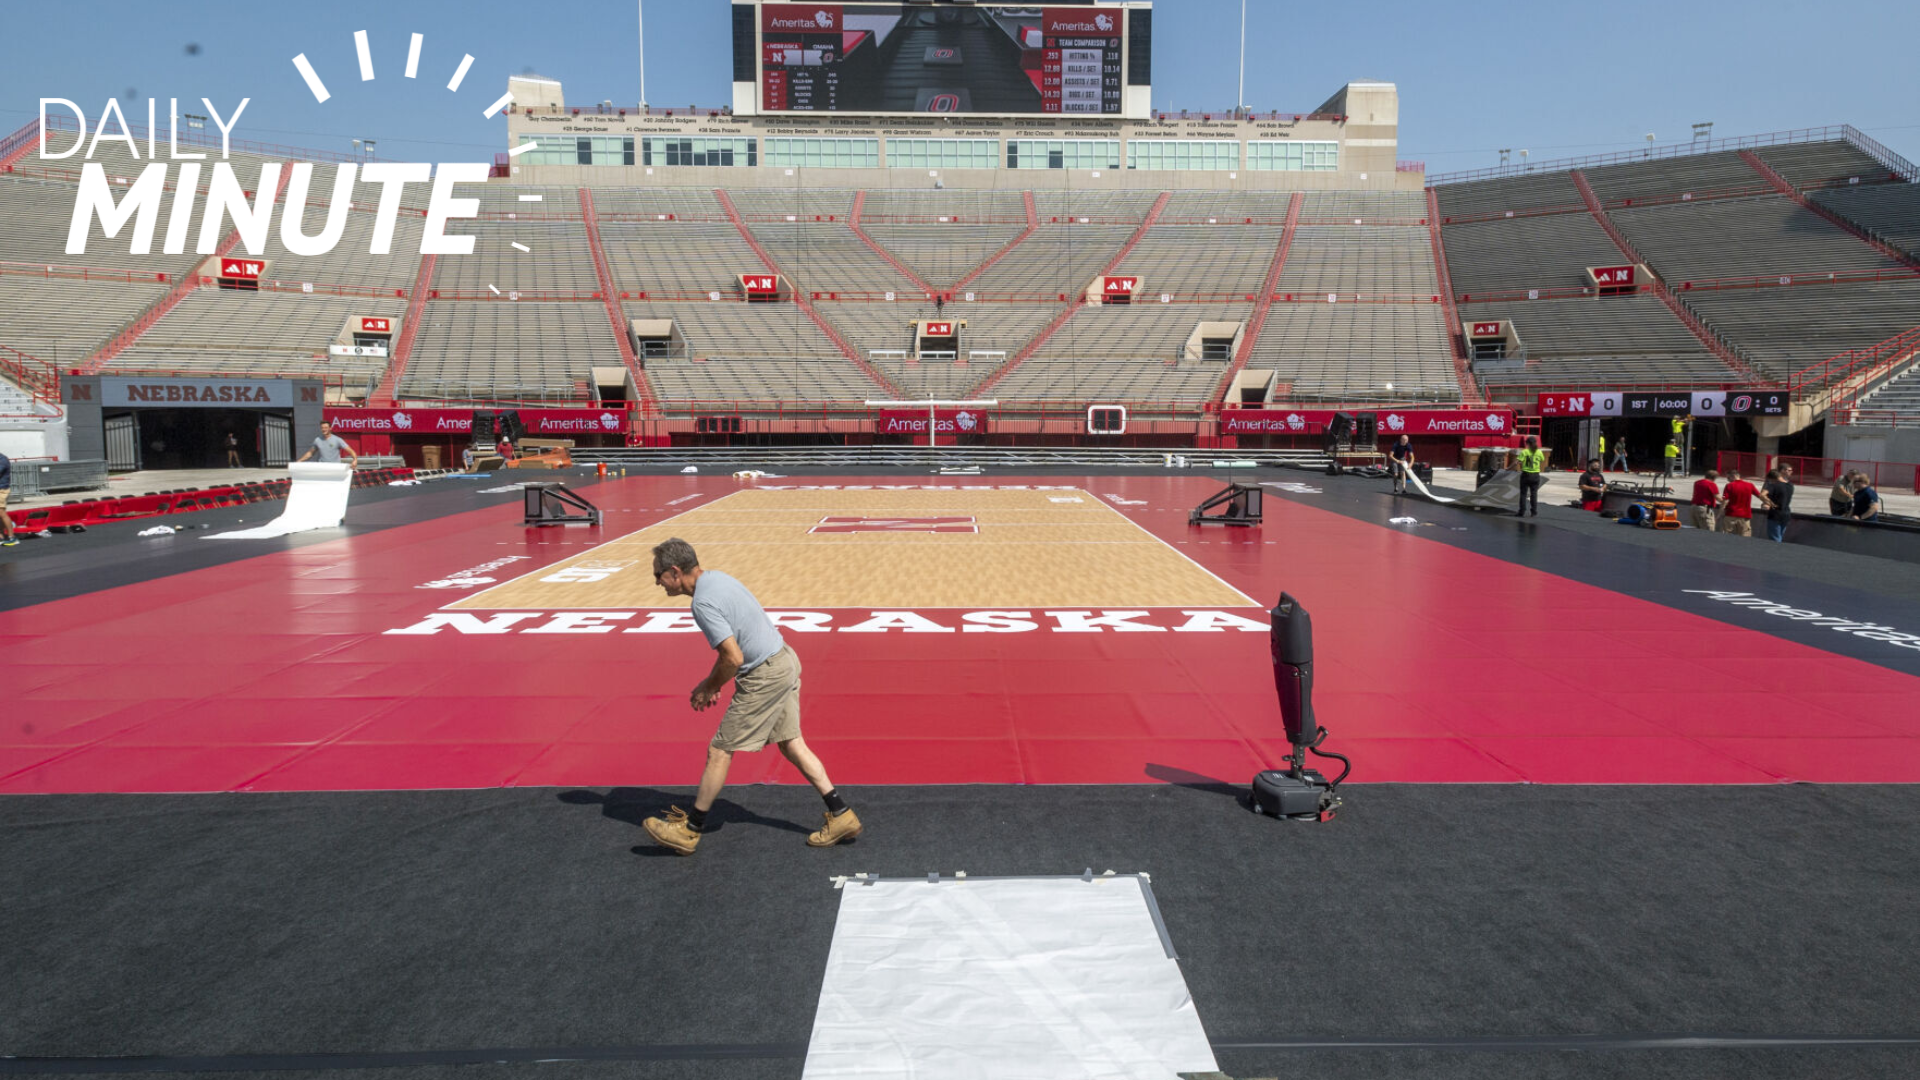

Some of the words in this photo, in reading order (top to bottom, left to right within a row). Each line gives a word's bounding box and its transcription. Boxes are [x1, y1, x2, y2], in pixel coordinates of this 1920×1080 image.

[771, 17, 816, 28] Ameritas
[1051, 21, 1096, 31] Ameritas
[1059, 39, 1073, 47] TEAM
[1073, 39, 1107, 47] COMPARISON
[772, 52, 783, 62] N
[246, 263, 260, 275] N
[1616, 270, 1628, 281] N
[761, 278, 772, 289] N
[1122, 280, 1133, 290] N
[377, 320, 386, 329] N
[940, 324, 949, 333] N
[1487, 325, 1496, 333] N
[70, 384, 92, 401] N
[127, 384, 272, 402] NEBRASKA
[300, 386, 319, 402] N
[1546, 397, 1554, 406] 0
[1568, 397, 1586, 412] N
[1603, 398, 1614, 411] 0
[1632, 400, 1648, 408] 1ST
[1659, 400, 1688, 409] 60:00
[1701, 398, 1712, 410] 0
[1770, 396, 1778, 405] 0
[331, 416, 391, 430] Ameritas
[540, 416, 599, 430] Ameritas
[887, 417, 954, 431] Amertas
[1227, 418, 1286, 431] Ameritas
[1427, 417, 1484, 431] Ameritas
[381, 609, 1272, 635] NEBRASKA
